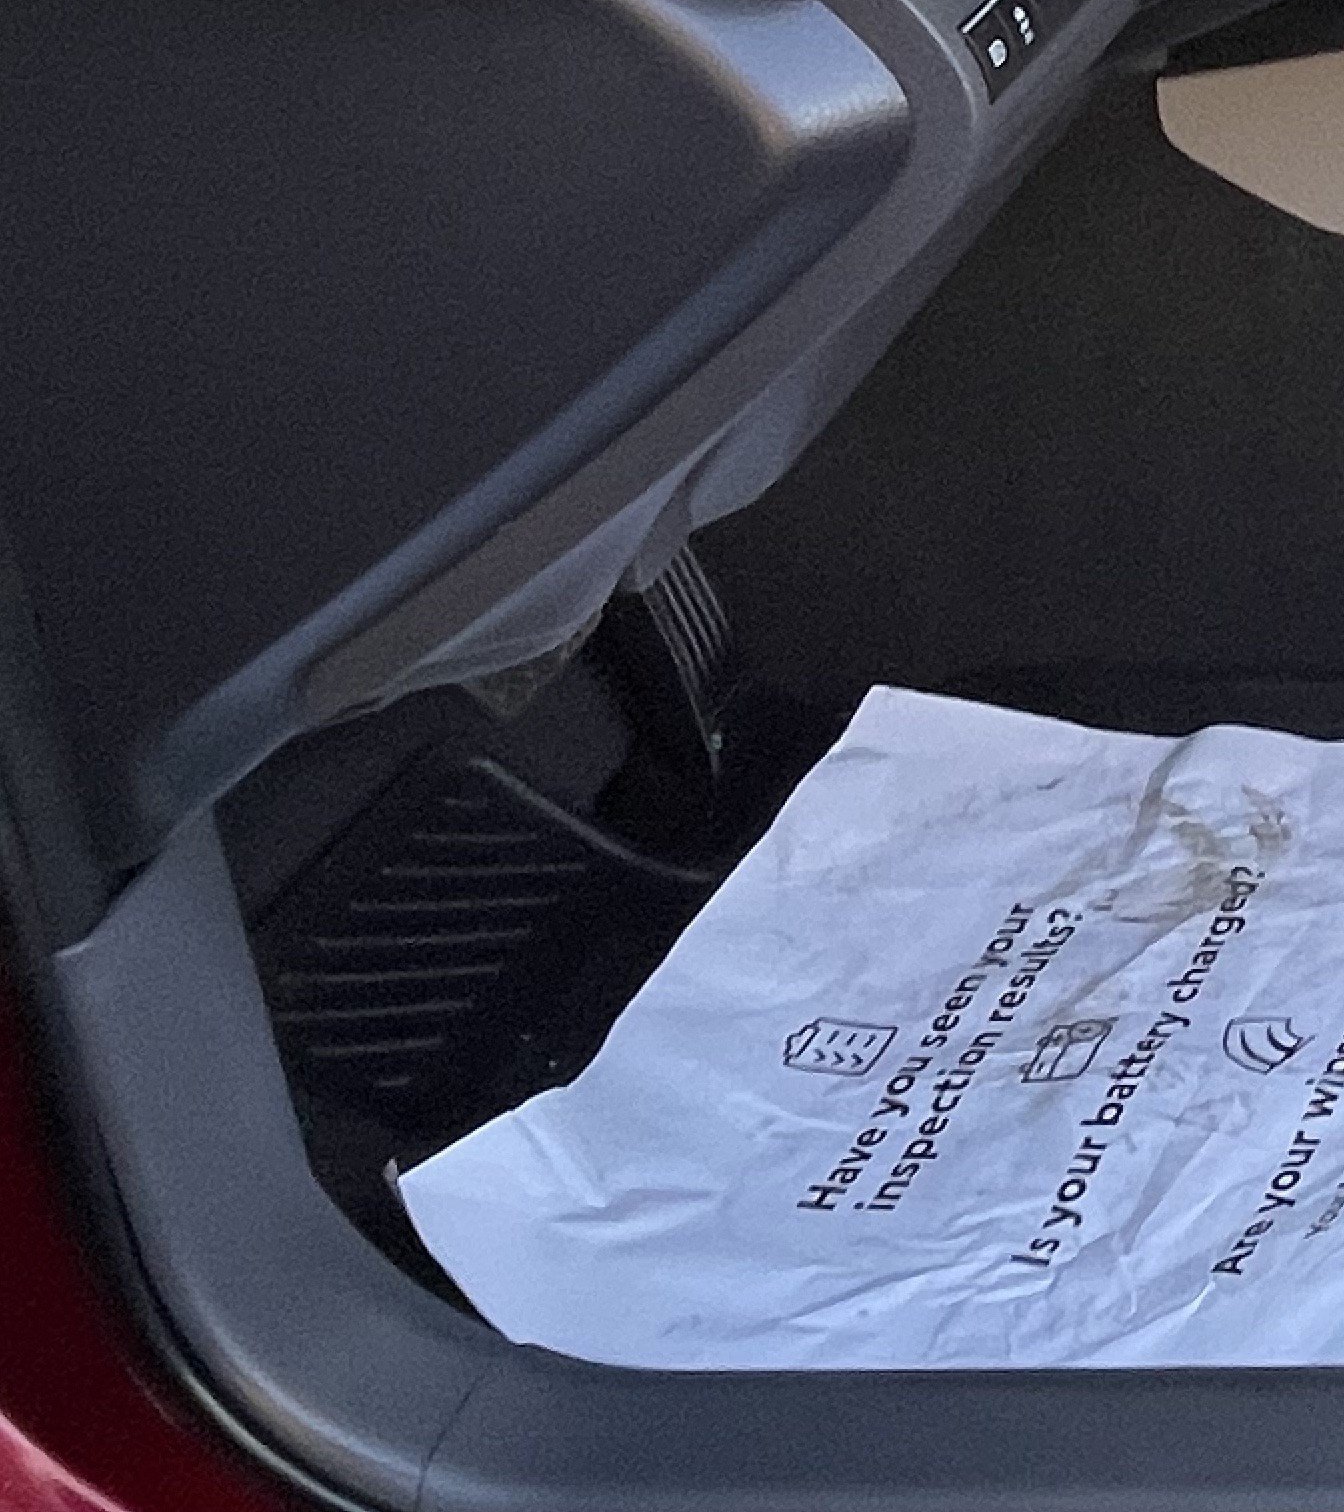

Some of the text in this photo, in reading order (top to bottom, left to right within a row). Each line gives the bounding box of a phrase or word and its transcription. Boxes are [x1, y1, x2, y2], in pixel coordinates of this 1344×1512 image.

[796, 902, 1034, 1210] Have you seen your
[853, 908, 1083, 1210] inspection results?
[1010, 866, 1266, 1267] Is your battery charged?
[1212, 1219, 1273, 1275] Are
[1259, 1131, 1320, 1213] your
